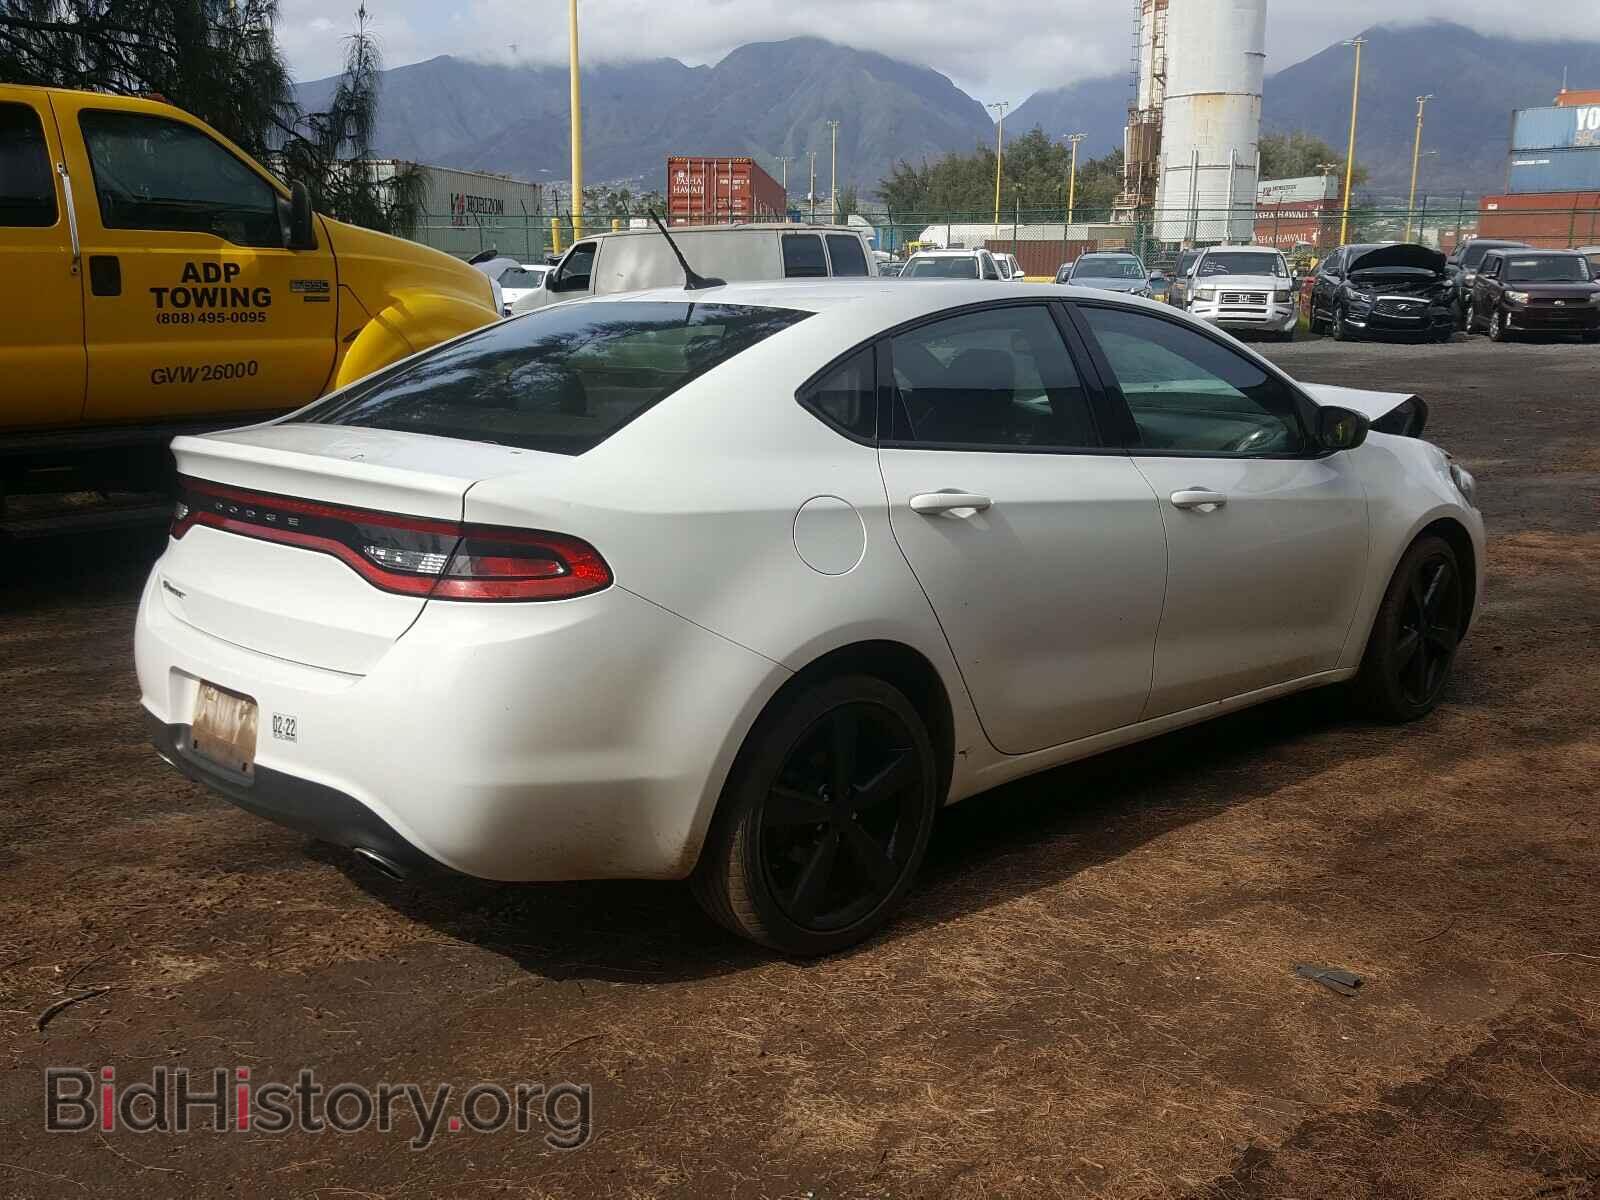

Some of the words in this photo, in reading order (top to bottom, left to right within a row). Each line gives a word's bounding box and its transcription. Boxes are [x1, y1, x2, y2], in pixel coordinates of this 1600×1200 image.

[675, 177, 702, 185] PASHA
[466, 194, 504, 215] HORIZON
[1277, 210, 1308, 218] HAWAII
[181, 262, 240, 283] ADP
[149, 287, 272, 308] TOWING
[156, 313, 194, 324] (808)
[198, 312, 267, 323] 495-0095
